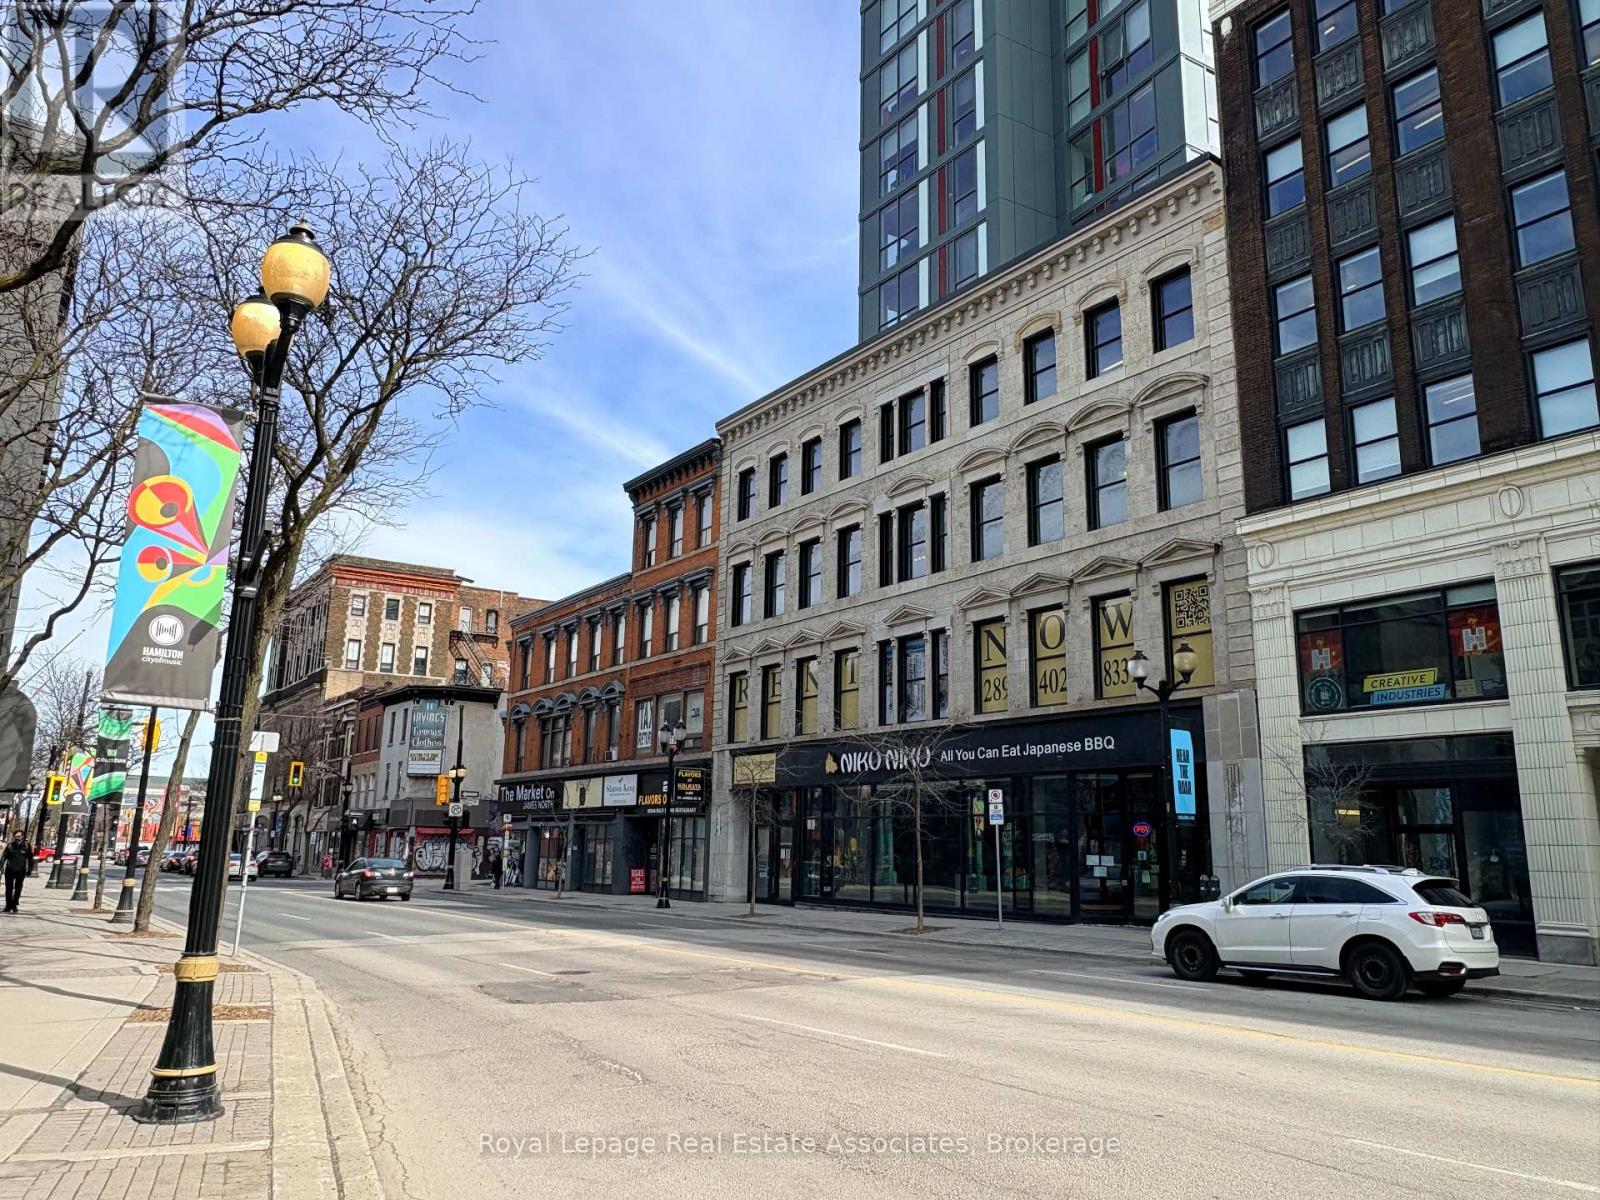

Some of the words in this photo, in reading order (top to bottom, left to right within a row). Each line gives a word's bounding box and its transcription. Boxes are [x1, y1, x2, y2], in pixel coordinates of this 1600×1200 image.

[984, 604, 1133, 662] NOW
[142, 646, 184, 660] HAMILTON
[1039, 666, 1067, 695] 402
[1371, 674, 1427, 689] CREATIVE
[1377, 687, 1441, 702] INDUSTRIES
[413, 711, 446, 724] IRVING'S
[413, 726, 442, 737] Famous
[412, 736, 442, 748] Clothes
[940, 749, 954, 762] All
[955, 748, 975, 762] You
[976, 747, 999, 760] Can
[1001, 744, 1021, 758] Eat
[1023, 740, 1082, 758] Japanese
[1084, 735, 1115, 751] BBQ
[500, 786, 514, 802] The
[516, 784, 544, 801] Market
[545, 787, 555, 799] On
[638, 794, 661, 806] FLAVORS
